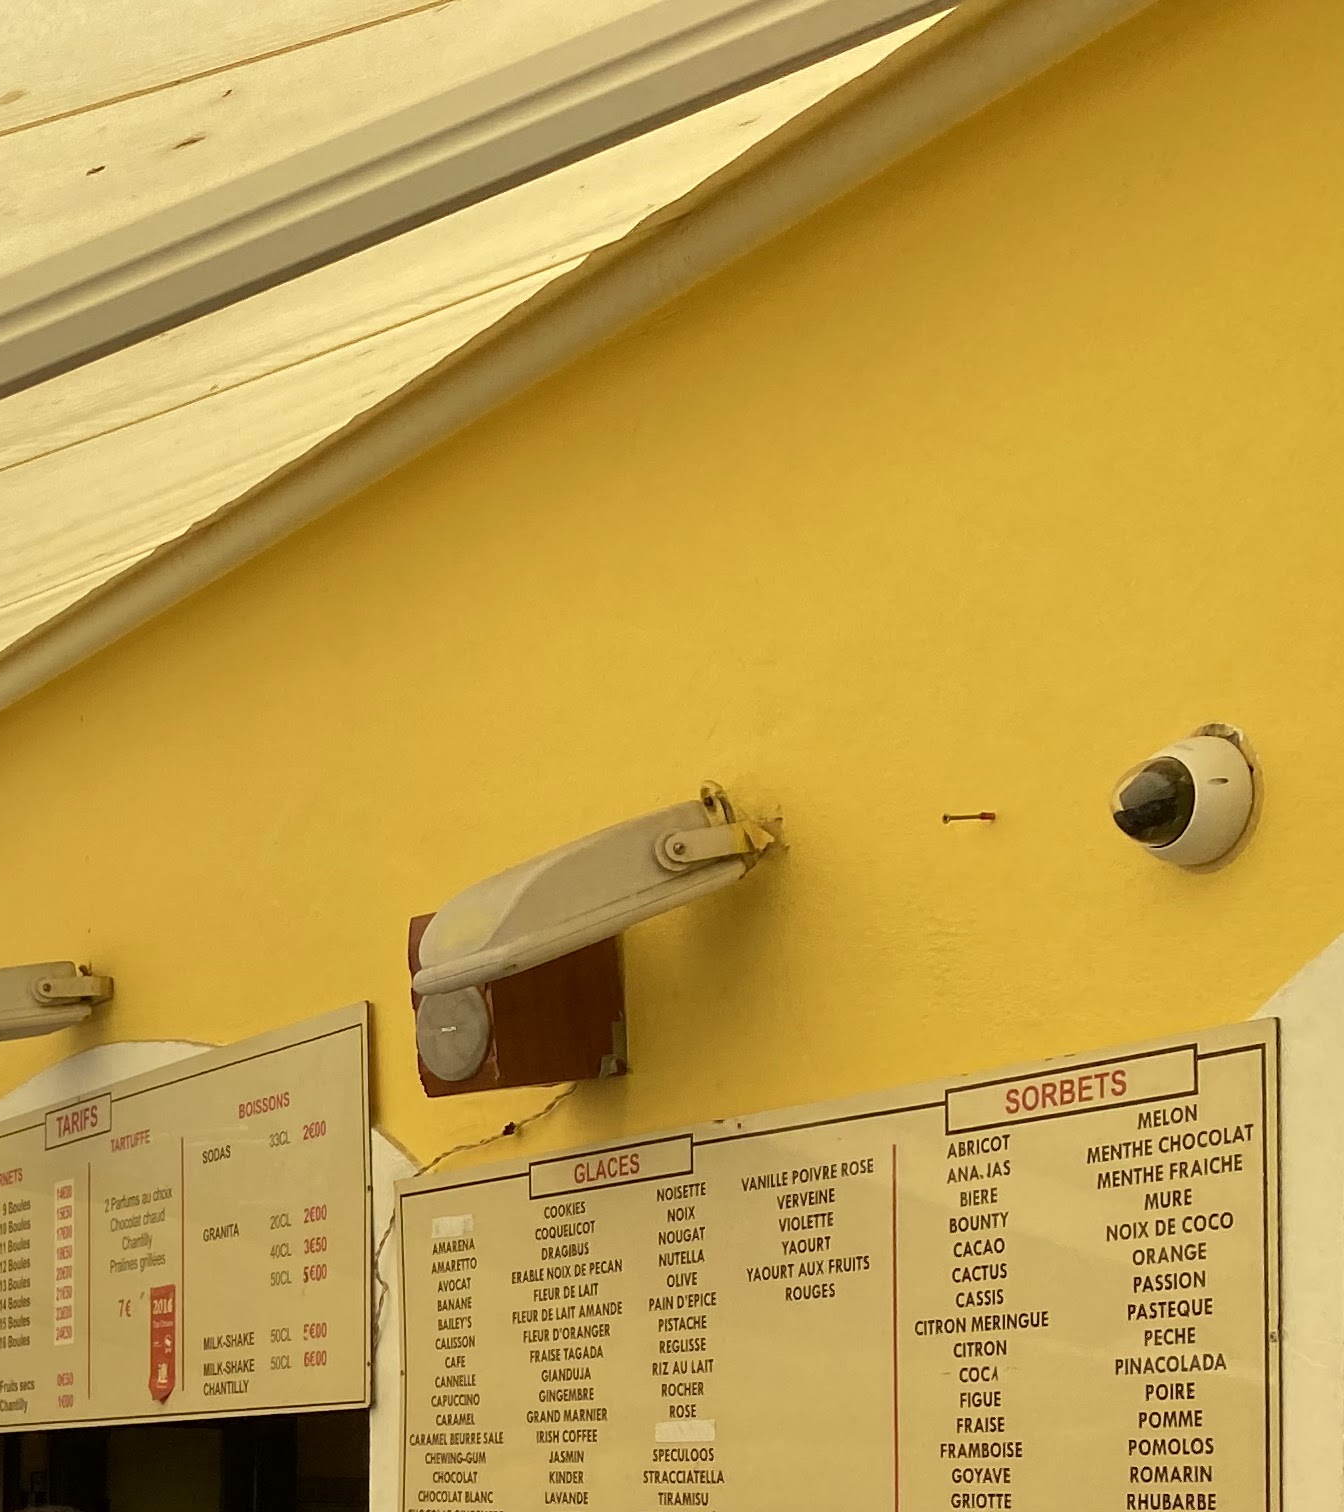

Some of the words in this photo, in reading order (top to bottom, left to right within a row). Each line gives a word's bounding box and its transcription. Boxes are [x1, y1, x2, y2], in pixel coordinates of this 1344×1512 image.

[1005, 1069, 1128, 1115] SORBETS
[238, 1092, 290, 1120] BOISSONS
[56, 1105, 98, 1139] TARIFS
[1137, 1104, 1198, 1130] MELON
[110, 1128, 151, 1153] TARTUFFE
[202, 1144, 231, 1164] SODAS
[303, 1120, 326, 1141] 2€00
[946, 1134, 1011, 1159] ABRICOT
[1086, 1139, 1153, 1164] MENTHE
[1158, 1123, 1254, 1154] CHOCOLAT
[573, 1152, 641, 1186] GLACES
[741, 1171, 788, 1192] VANILLE
[792, 1164, 838, 1185] POIVRE
[841, 1158, 874, 1178] ROSE
[1097, 1164, 1164, 1190] MENTHE
[1169, 1154, 1243, 1180] FRAICHE
[656, 1182, 706, 1202] NOISETTE
[777, 1188, 836, 1210] VERVEINE
[960, 1187, 998, 1207] BIERE
[1144, 1189, 1193, 1210] MURE
[104, 1198, 110, 1214] 2
[544, 1201, 586, 1220] COOKIES
[667, 1205, 696, 1222] NOIX
[202, 1223, 240, 1242] GRANITA
[269, 1214, 292, 1231] 20CL
[303, 1204, 327, 1224] 2€00
[535, 1220, 596, 1241] COQUELICOT
[778, 1211, 834, 1232] VIOLETTE
[949, 1211, 1009, 1234] BOUNTY
[1106, 1221, 1149, 1242] NOIX
[1155, 1218, 1176, 1237] DE
[1182, 1212, 1234, 1234] COCO
[658, 1226, 705, 1246] NOUGAT
[781, 1236, 832, 1256] YAOURT
[269, 1243, 292, 1259] 40CL
[303, 1236, 327, 1255] 3€50
[541, 1242, 590, 1261] DRAGIBUS
[953, 1238, 1006, 1258] CACAO
[1132, 1243, 1207, 1266] ORANGE
[658, 1249, 705, 1267] NUTELLA
[270, 1270, 292, 1287] 50CL
[303, 1263, 327, 1283] 5€00
[746, 1263, 795, 1282] YAOURT
[798, 1260, 824, 1278] AUX
[828, 1255, 870, 1274] FRUITS
[952, 1263, 1008, 1283] CACTUS
[437, 1277, 472, 1294] AVOCAT
[666, 1272, 698, 1288] OLIVE
[1133, 1270, 1206, 1293] PASSION
[648, 1296, 674, 1312] PAIN
[677, 1292, 717, 1309] D'EPICE
[785, 1283, 836, 1301] ROUGES
[955, 1289, 1004, 1308] CASSIS
[118, 1299, 131, 1318] 7€
[437, 1297, 472, 1312] BANANE
[1127, 1298, 1213, 1321] PASTEQUE
[658, 1315, 707, 1333] PISTACHE
[914, 1317, 966, 1336] CITRON
[971, 1311, 1049, 1333] MERINGUE
[203, 1332, 255, 1351] MILK-SHAKE
[270, 1327, 292, 1343] 50CL
[659, 1337, 706, 1354] REGLISSE
[1144, 1327, 1196, 1346] PECHE
[953, 1340, 1008, 1358] CITRON
[203, 1358, 255, 1376] MILK-SHAKE
[270, 1354, 292, 1371] 50CL
[652, 1361, 669, 1376] RIZ
[673, 1360, 688, 1375] AU
[691, 1359, 714, 1374] LAIT
[959, 1366, 999, 1383] COCA
[1115, 1353, 1227, 1376] PINACOLADA
[203, 1379, 250, 1397] CHANTILLY
[661, 1381, 704, 1398] ROCHER
[1145, 1382, 1196, 1401] POIRE
[960, 1391, 1001, 1409] FIGUE
[669, 1404, 697, 1419] ROSE
[1138, 1410, 1203, 1429] POMME
[956, 1417, 1005, 1434] FRAISE
[652, 1448, 714, 1463] SPECULOOS
[940, 1442, 1023, 1459] FRAMBOISE
[549, 1471, 584, 1485] KINDER
[643, 1470, 725, 1485] STRACCIATELLA
[952, 1468, 1011, 1484] GOYAVE
[1130, 1466, 1212, 1483] ROMARIN
[544, 1491, 589, 1505] LAVANDE
[658, 1492, 709, 1506] TIRAMISU
[951, 1493, 1012, 1510] GRIOTTE
[1126, 1493, 1217, 1511] RHUBARBE
